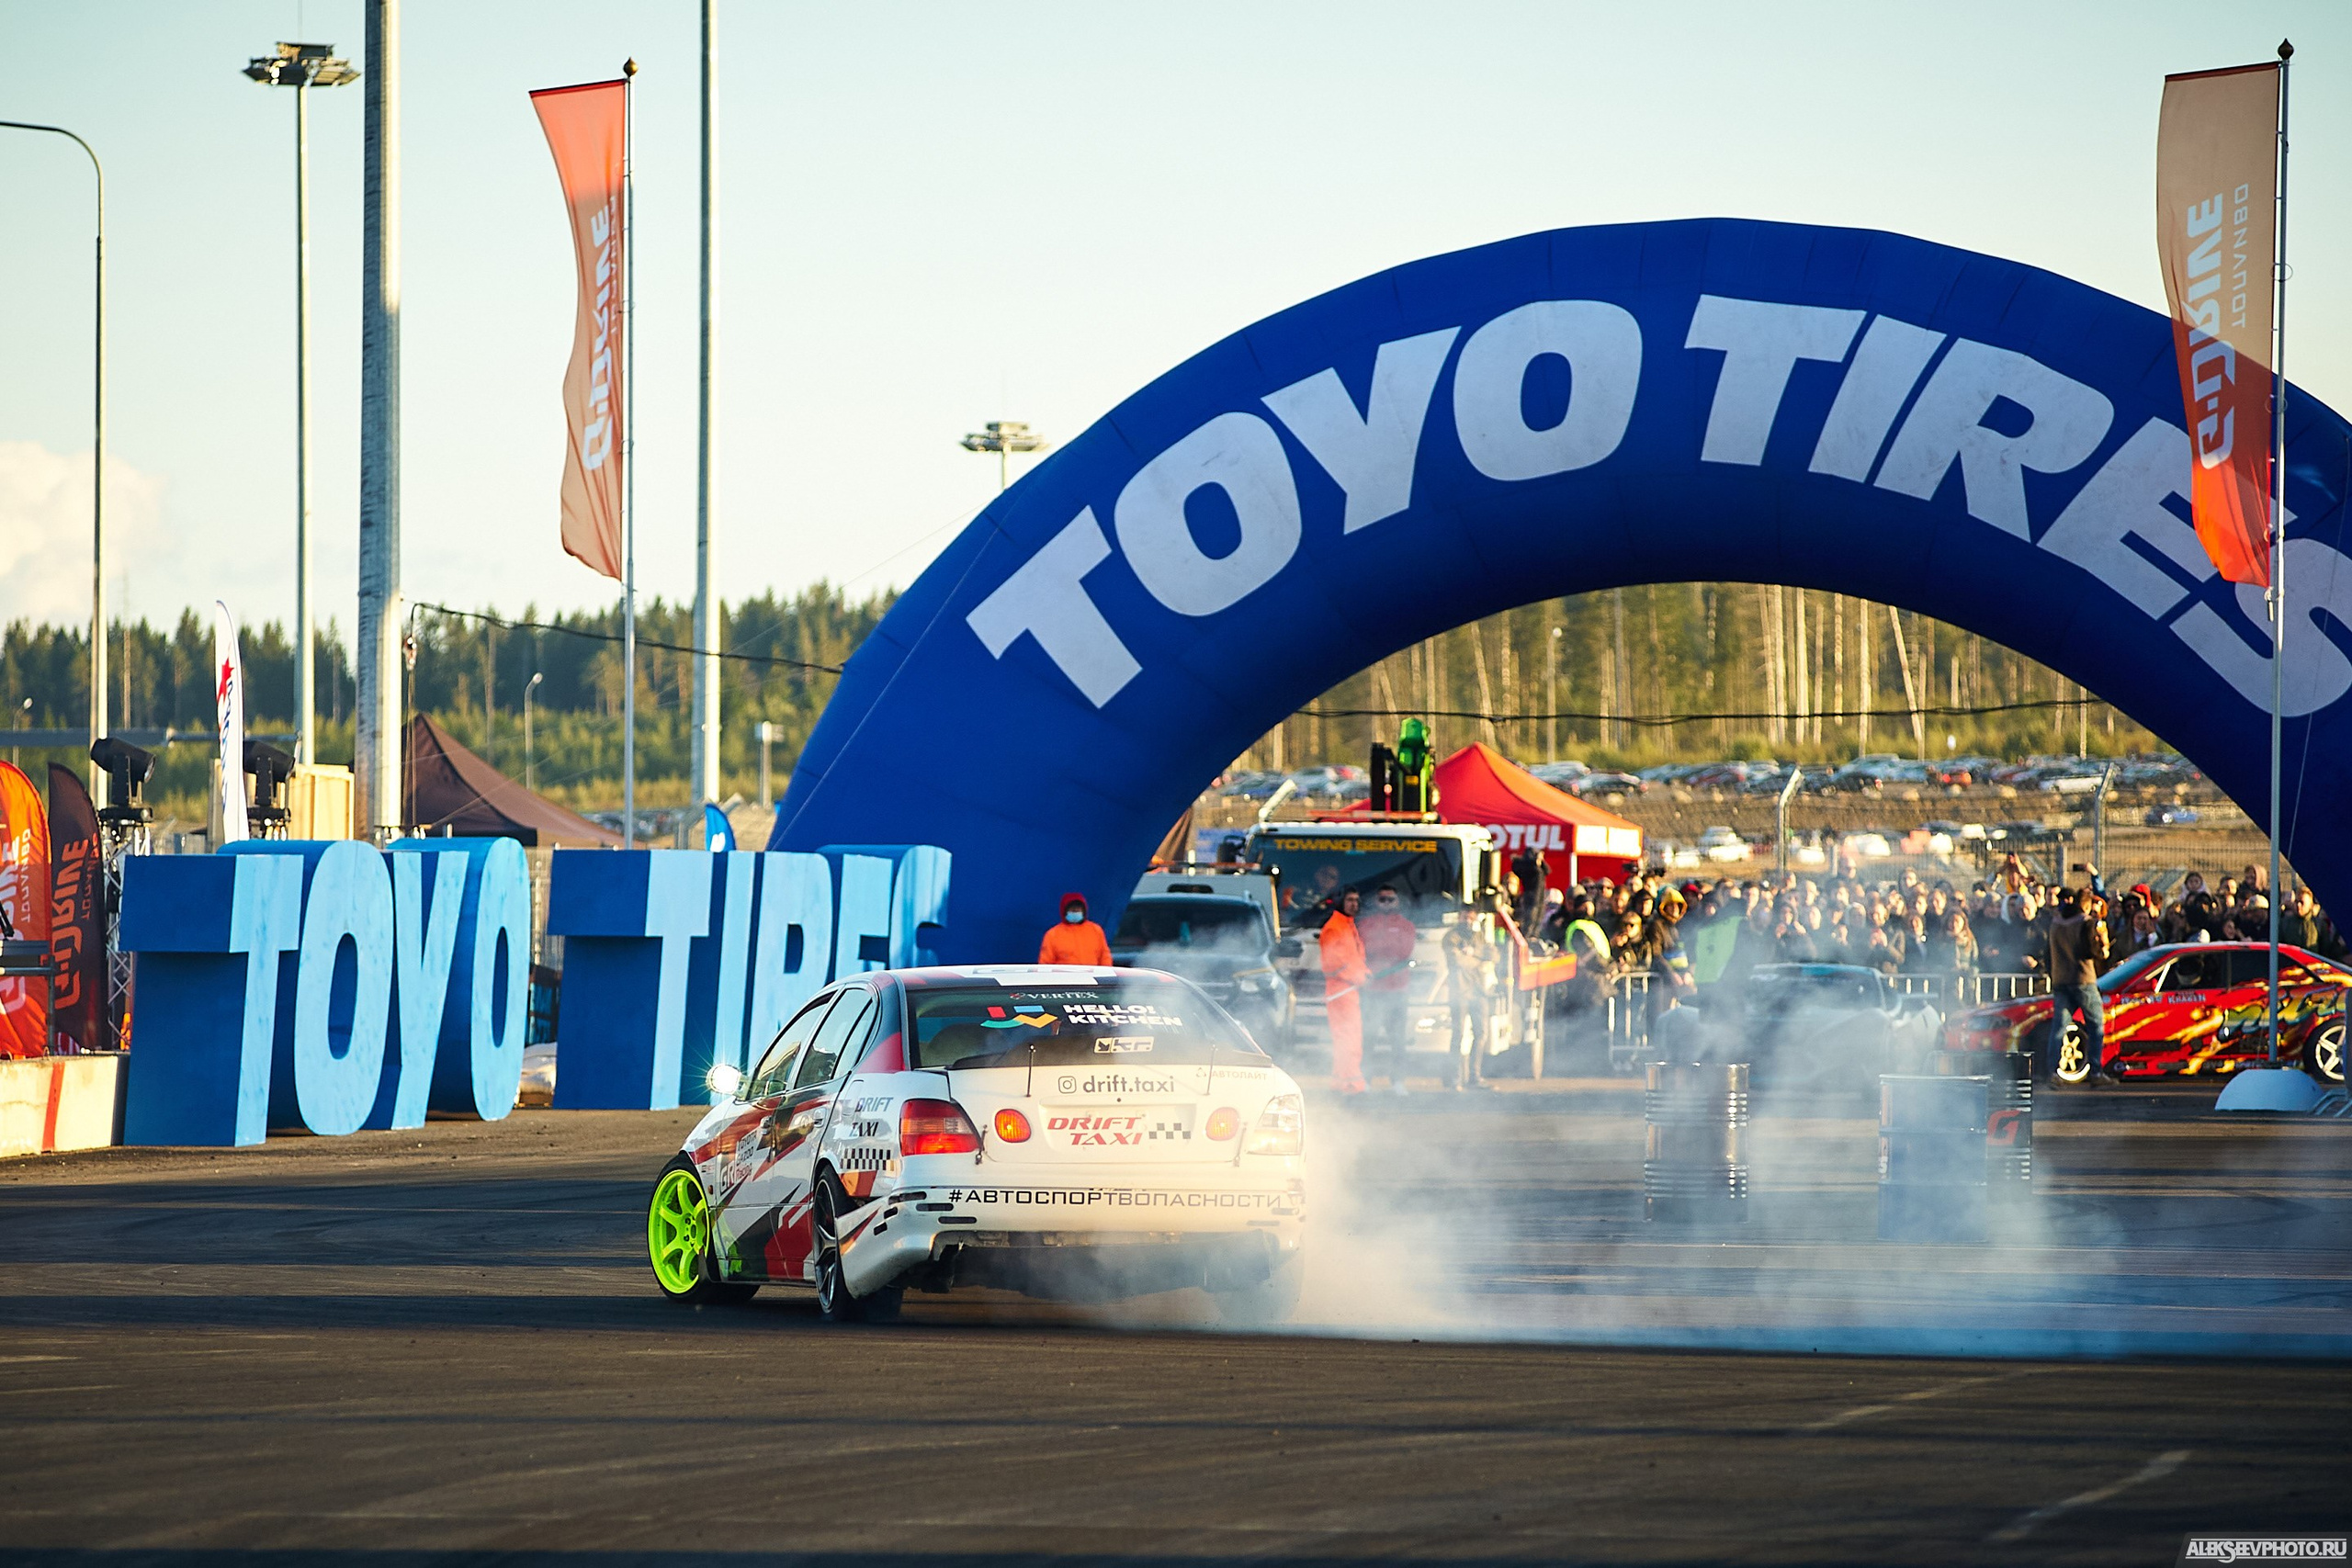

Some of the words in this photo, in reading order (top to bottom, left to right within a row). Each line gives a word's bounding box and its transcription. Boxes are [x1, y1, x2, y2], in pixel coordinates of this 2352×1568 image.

[966, 299, 1643, 708] TOYO
[1684, 294, 2352, 717] TIRES
[1486, 824, 1566, 850] OTUL
[1273, 838, 1351, 852] TOWING
[1354, 840, 1438, 852] SERVICE
[228, 836, 531, 1147] TOYO
[1062, 1004, 1158, 1015] HELLO!
[1069, 1014, 1183, 1027] KITCHEN
[1082, 1074, 1175, 1093] drift.taxi
[854, 1097, 894, 1112] DRIFT
[849, 1122, 879, 1137] TAXI
[1046, 1117, 1143, 1131] DRIFT
[1070, 1132, 1144, 1146] TAXI
[948, 1189, 1283, 1209] #АВТОСПОРТВОПАСНОСТИ
